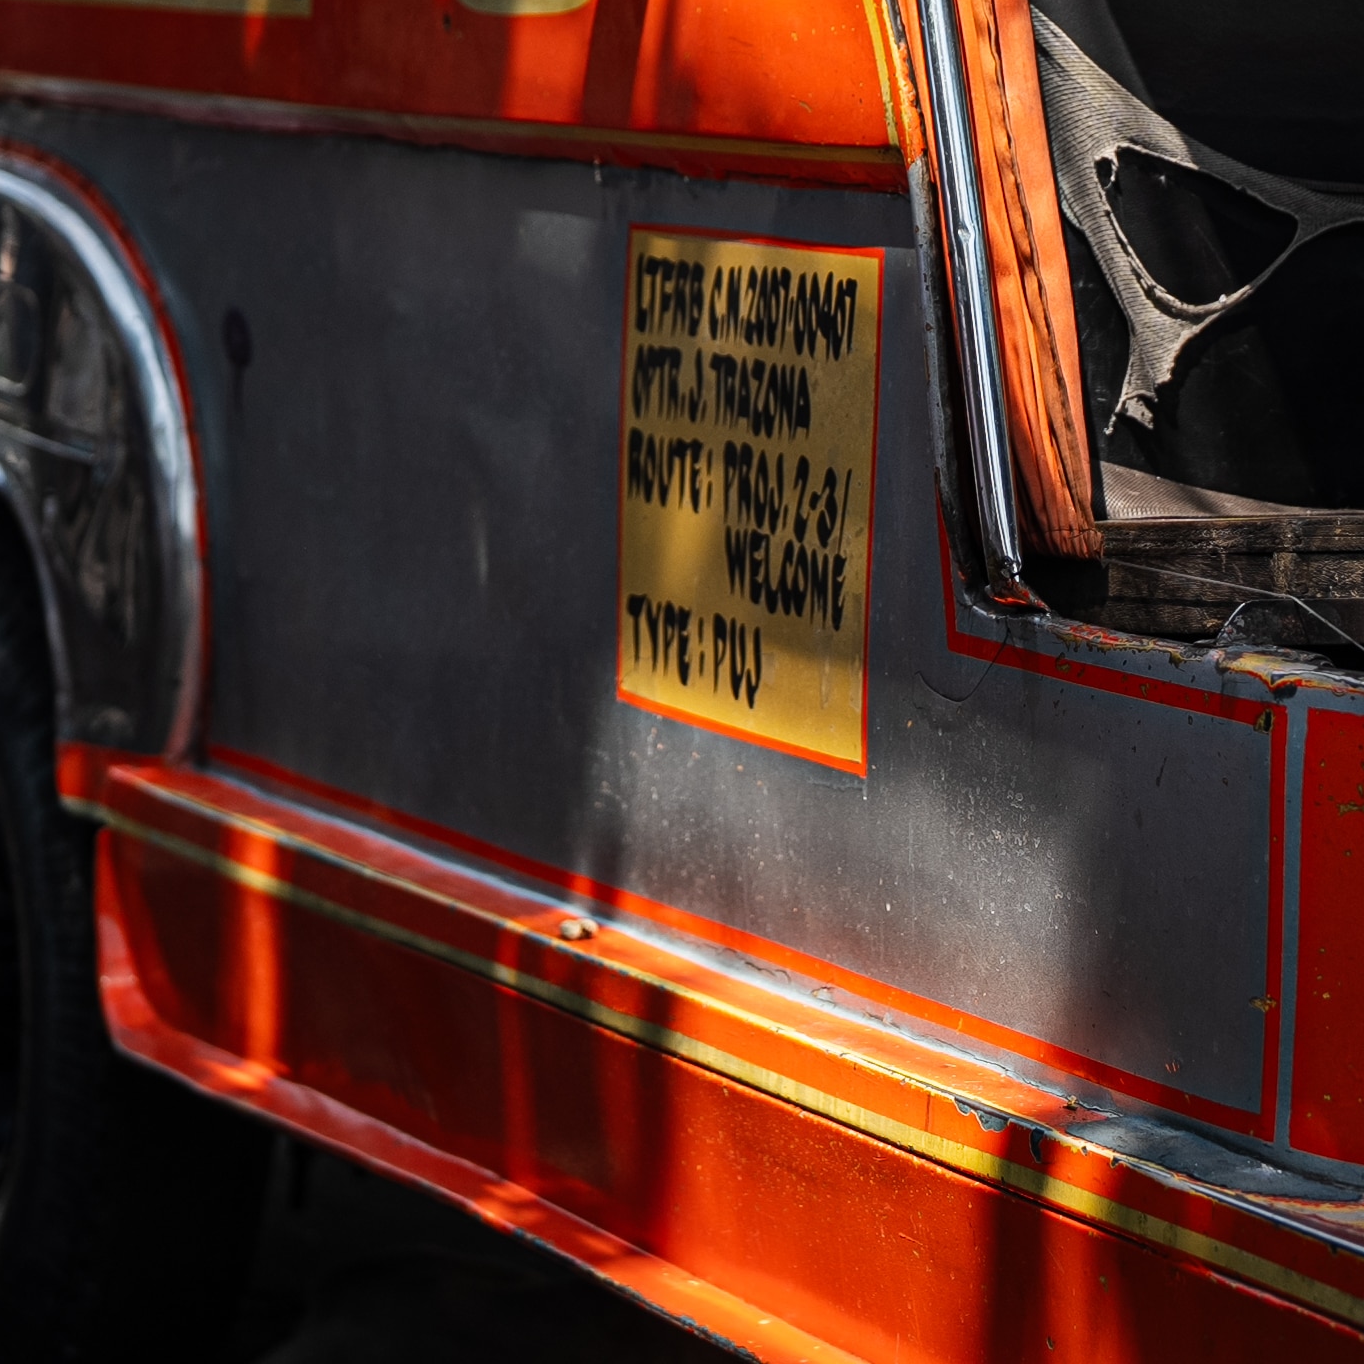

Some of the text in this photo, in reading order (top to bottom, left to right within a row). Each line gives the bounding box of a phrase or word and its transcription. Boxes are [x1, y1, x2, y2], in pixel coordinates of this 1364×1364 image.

[635, 251, 705, 338] LTFRB
[724, 525, 848, 632] WELCOME
[711, 611, 763, 710] PUJ
